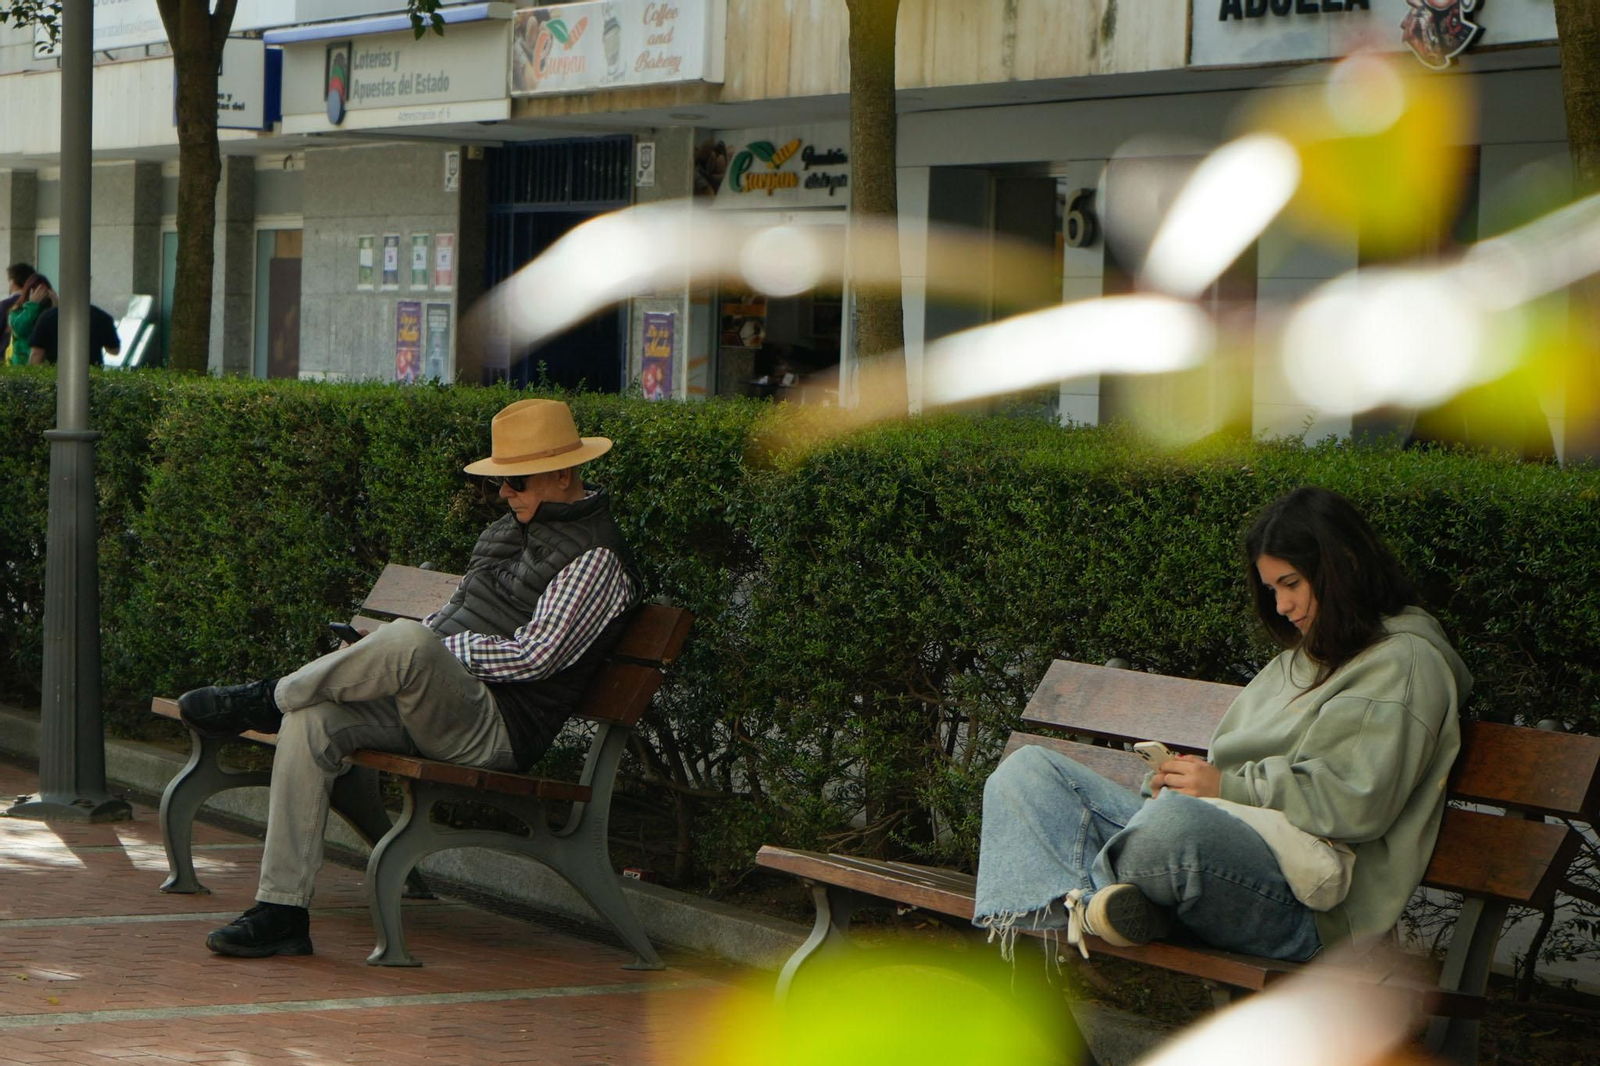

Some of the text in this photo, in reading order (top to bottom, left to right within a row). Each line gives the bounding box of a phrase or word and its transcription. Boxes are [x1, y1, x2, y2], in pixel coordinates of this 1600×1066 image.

[643, 2, 679, 27] Coffee
[647, 26, 674, 46] and
[353, 46, 400, 72] Loterías y
[634, 50, 682, 74] Bakery
[226, 93, 233, 102] y
[353, 70, 450, 104] Apuestas del Estado
[232, 102, 245, 111] del
[1062, 188, 1093, 248] 6
